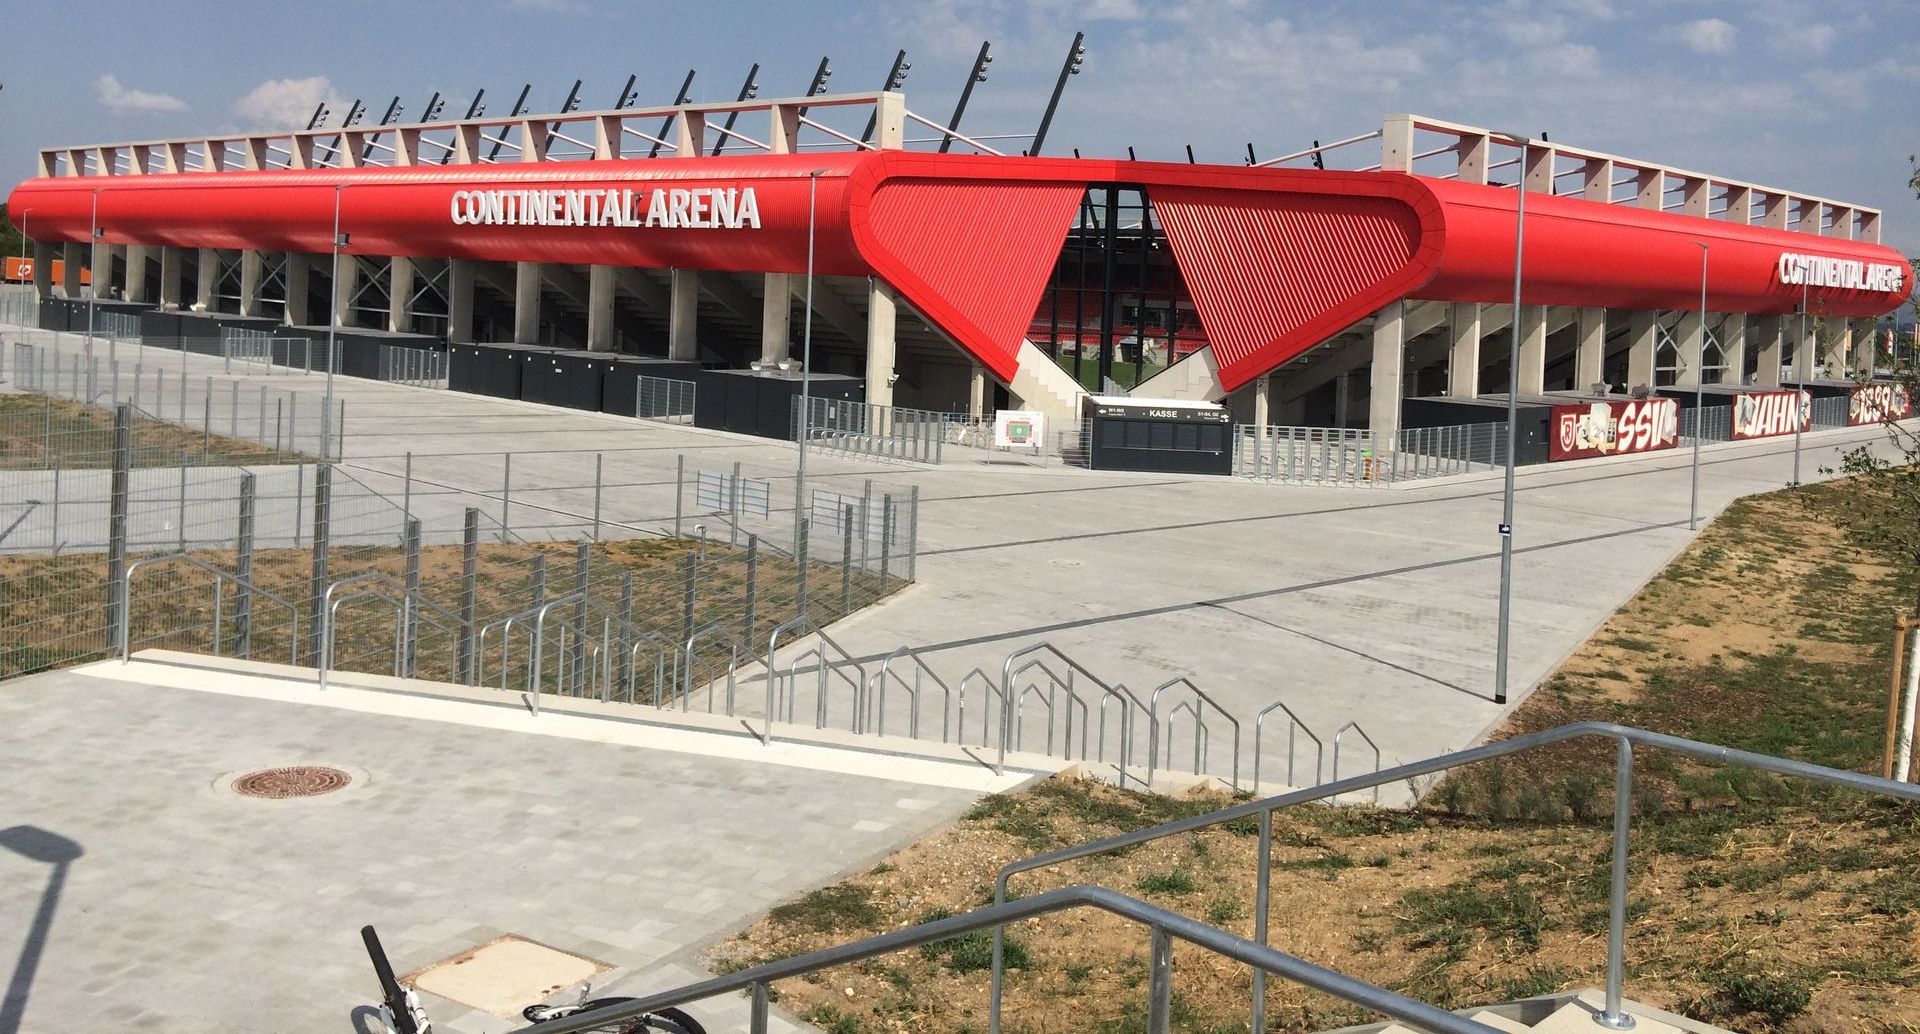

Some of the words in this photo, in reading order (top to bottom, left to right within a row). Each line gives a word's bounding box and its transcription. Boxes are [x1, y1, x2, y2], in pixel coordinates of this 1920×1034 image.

[450, 189, 640, 227] CONTINENTAL
[645, 187, 761, 229] ARENA
[1779, 252, 1866, 290] CONTINENTAL
[1149, 409, 1178, 418] KASSE
[1744, 393, 1799, 437] JAHN
